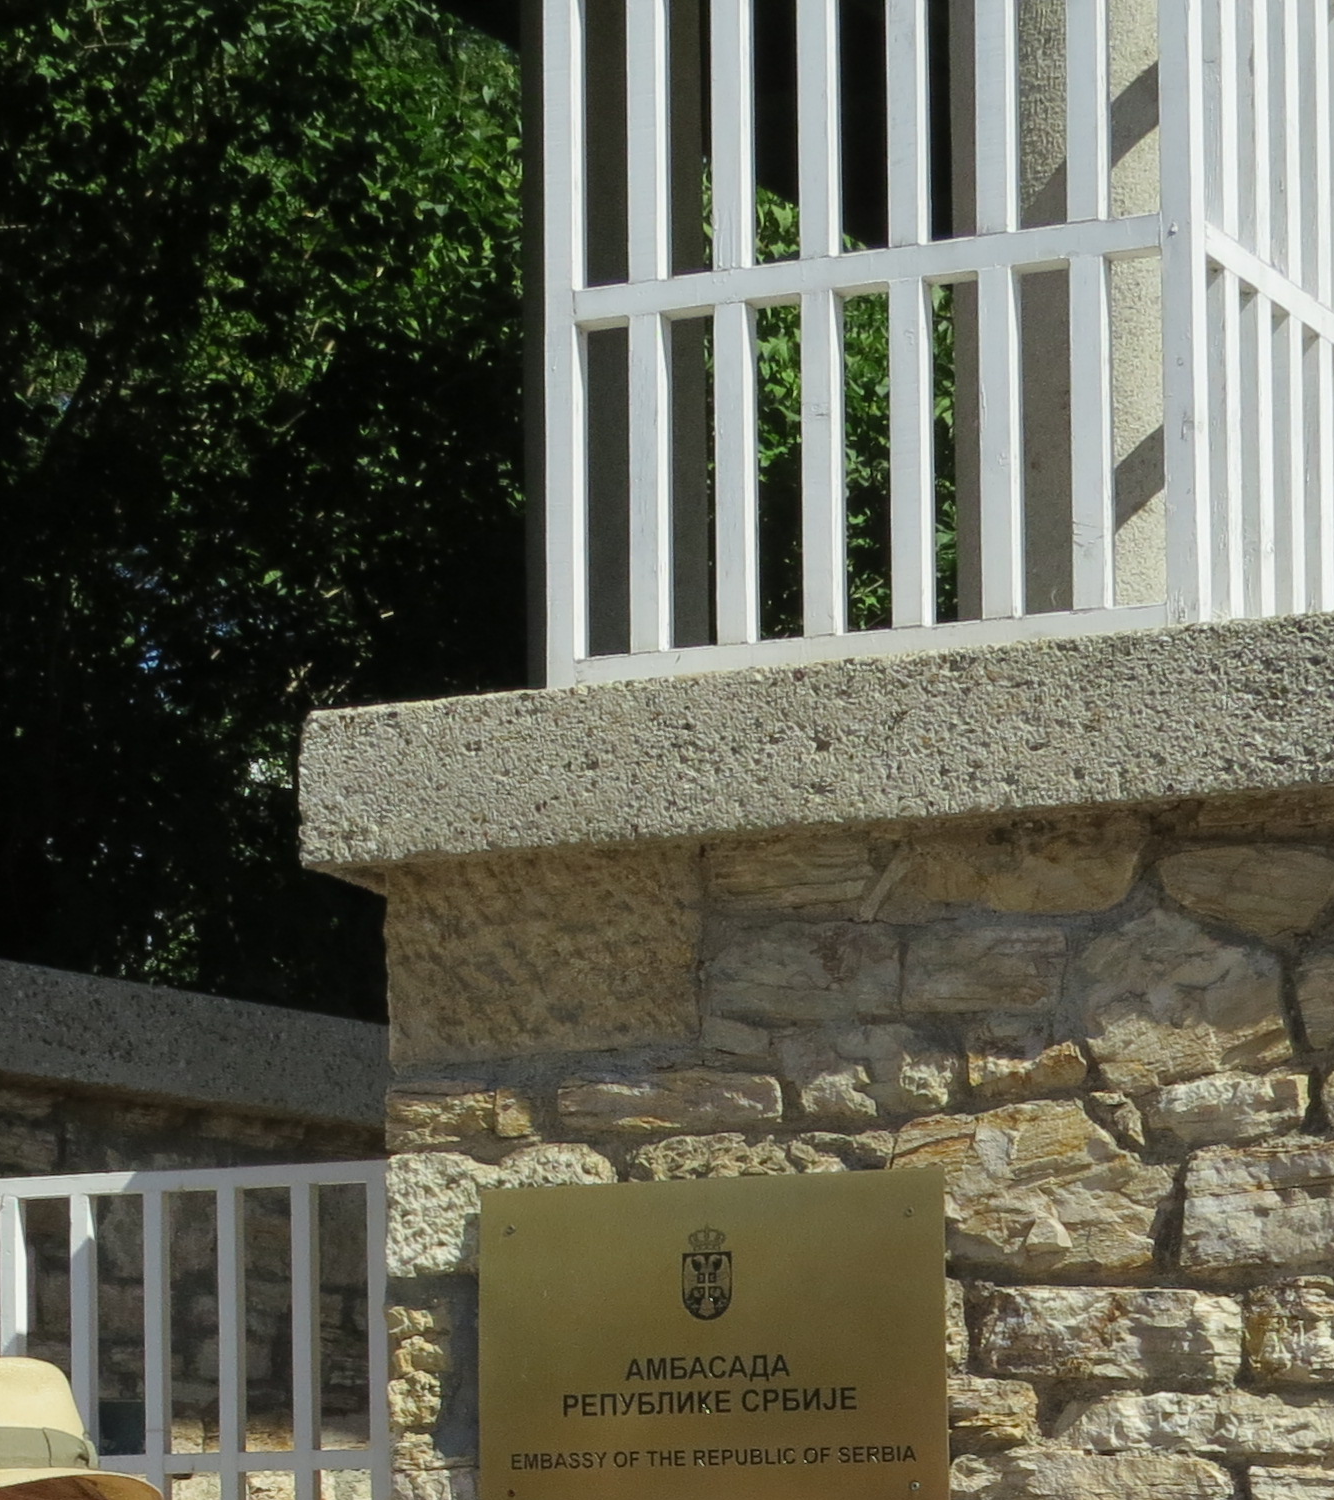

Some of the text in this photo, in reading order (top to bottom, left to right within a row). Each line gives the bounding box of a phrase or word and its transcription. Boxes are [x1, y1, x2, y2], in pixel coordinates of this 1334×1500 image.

[625, 1354, 790, 1382] АМБАСАДА
[562, 1387, 857, 1417] РЕПУБЛИКЕ СРБИЈЕ
[511, 1446, 917, 1470] EMBASSY OF THE REPUBLIC OF SERBIA
